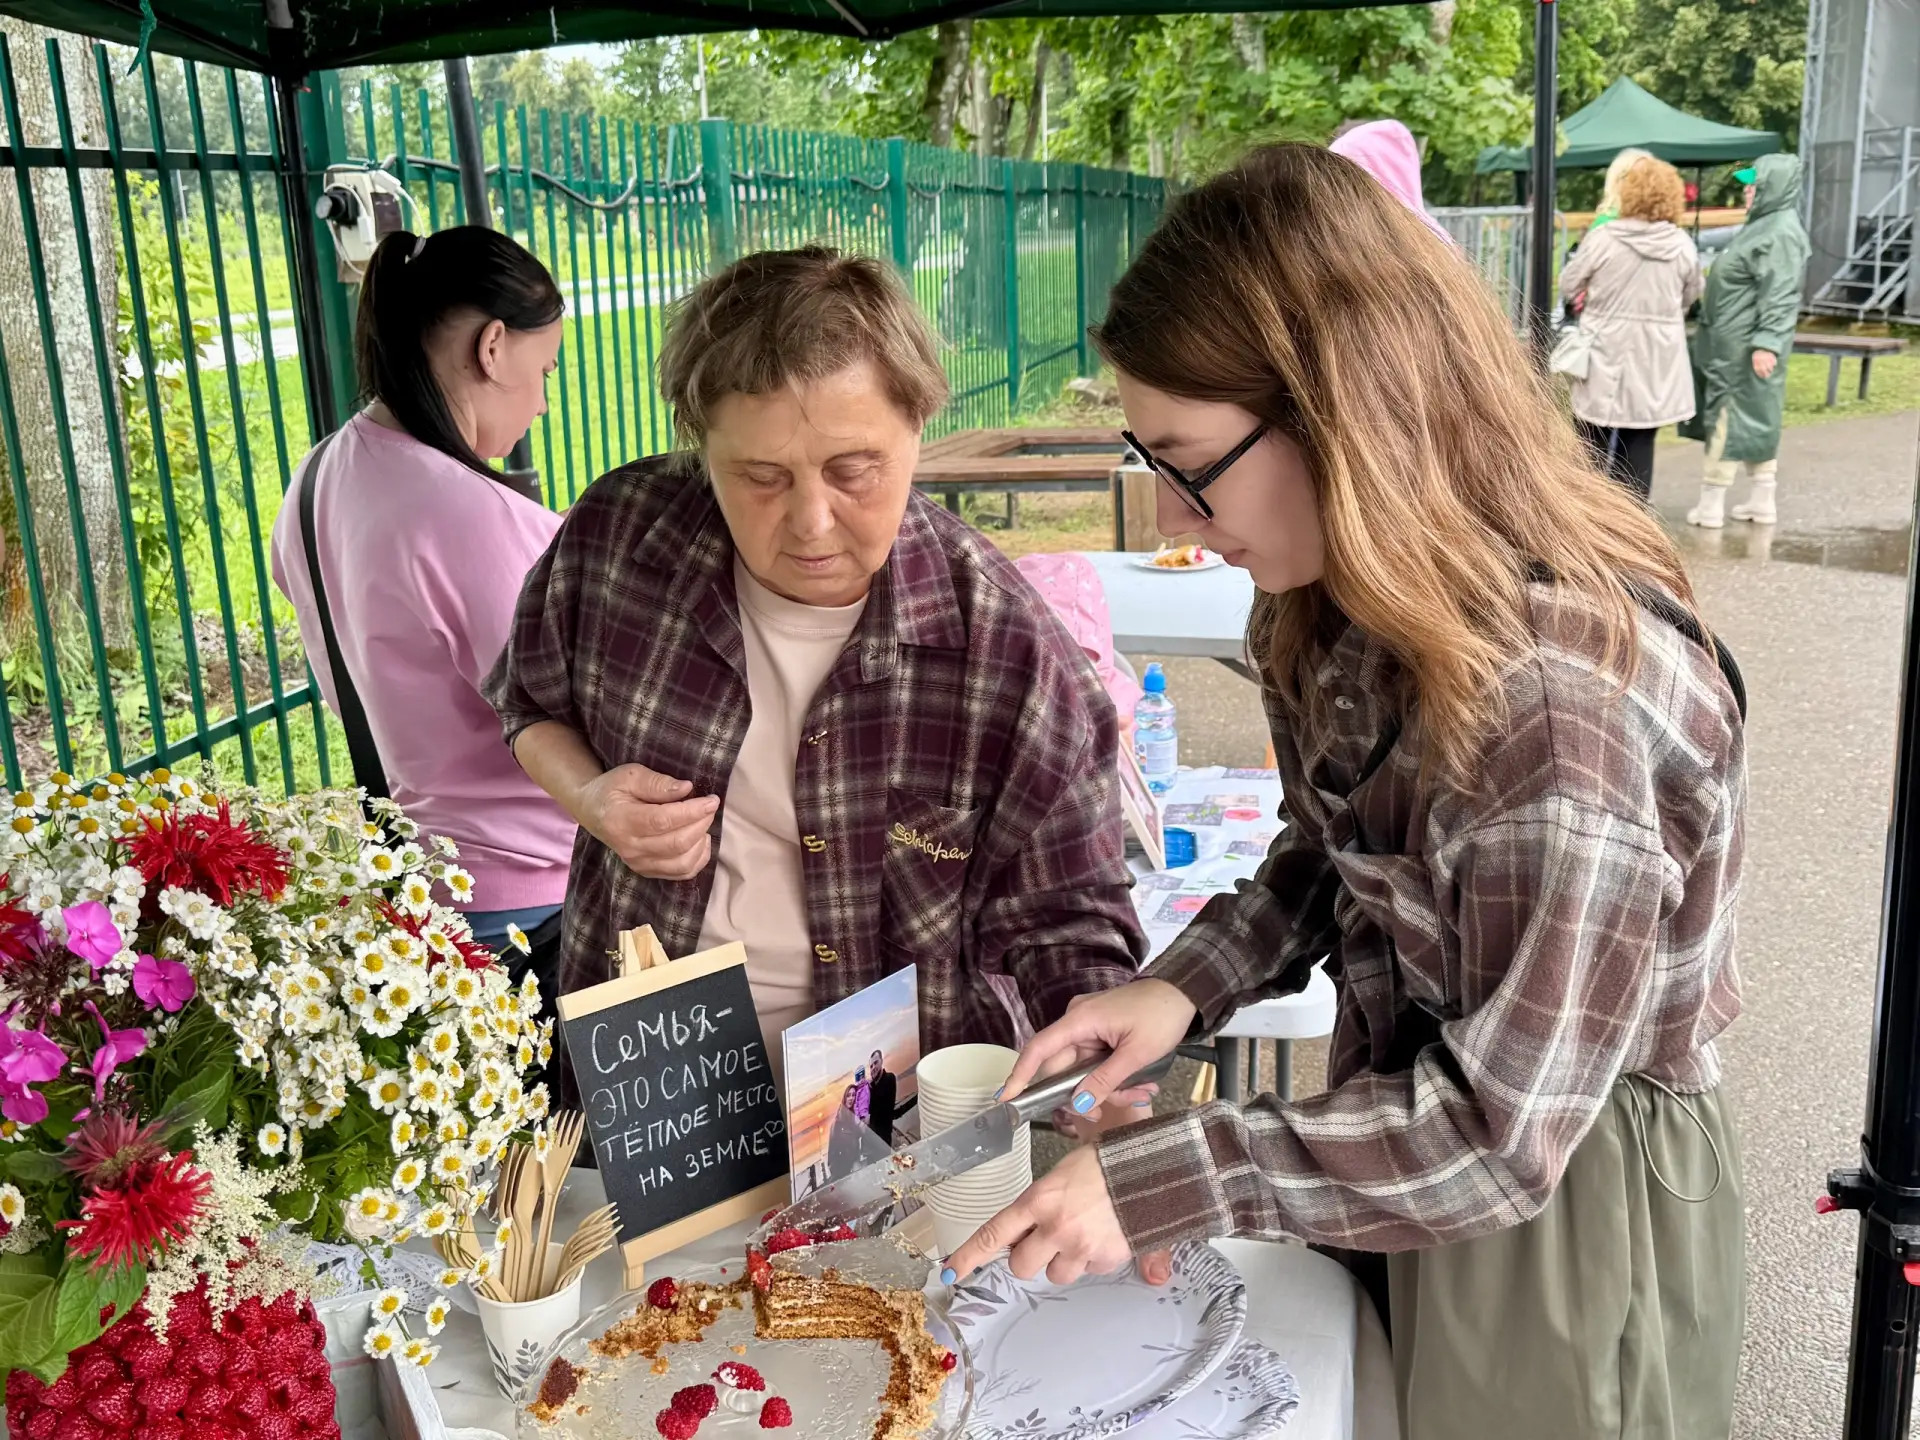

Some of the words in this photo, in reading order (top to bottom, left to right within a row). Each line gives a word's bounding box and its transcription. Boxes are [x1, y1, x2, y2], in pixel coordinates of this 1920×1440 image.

[591, 1076, 650, 1129] ЭТО
[660, 1042, 763, 1101] САМОЕ
[599, 1103, 711, 1162] ТЁПЛОЕ
[717, 1083, 778, 1119] МЕСТО
[638, 1166, 674, 1196] НА
[685, 1129, 769, 1178] ЗЕМЛЕ
